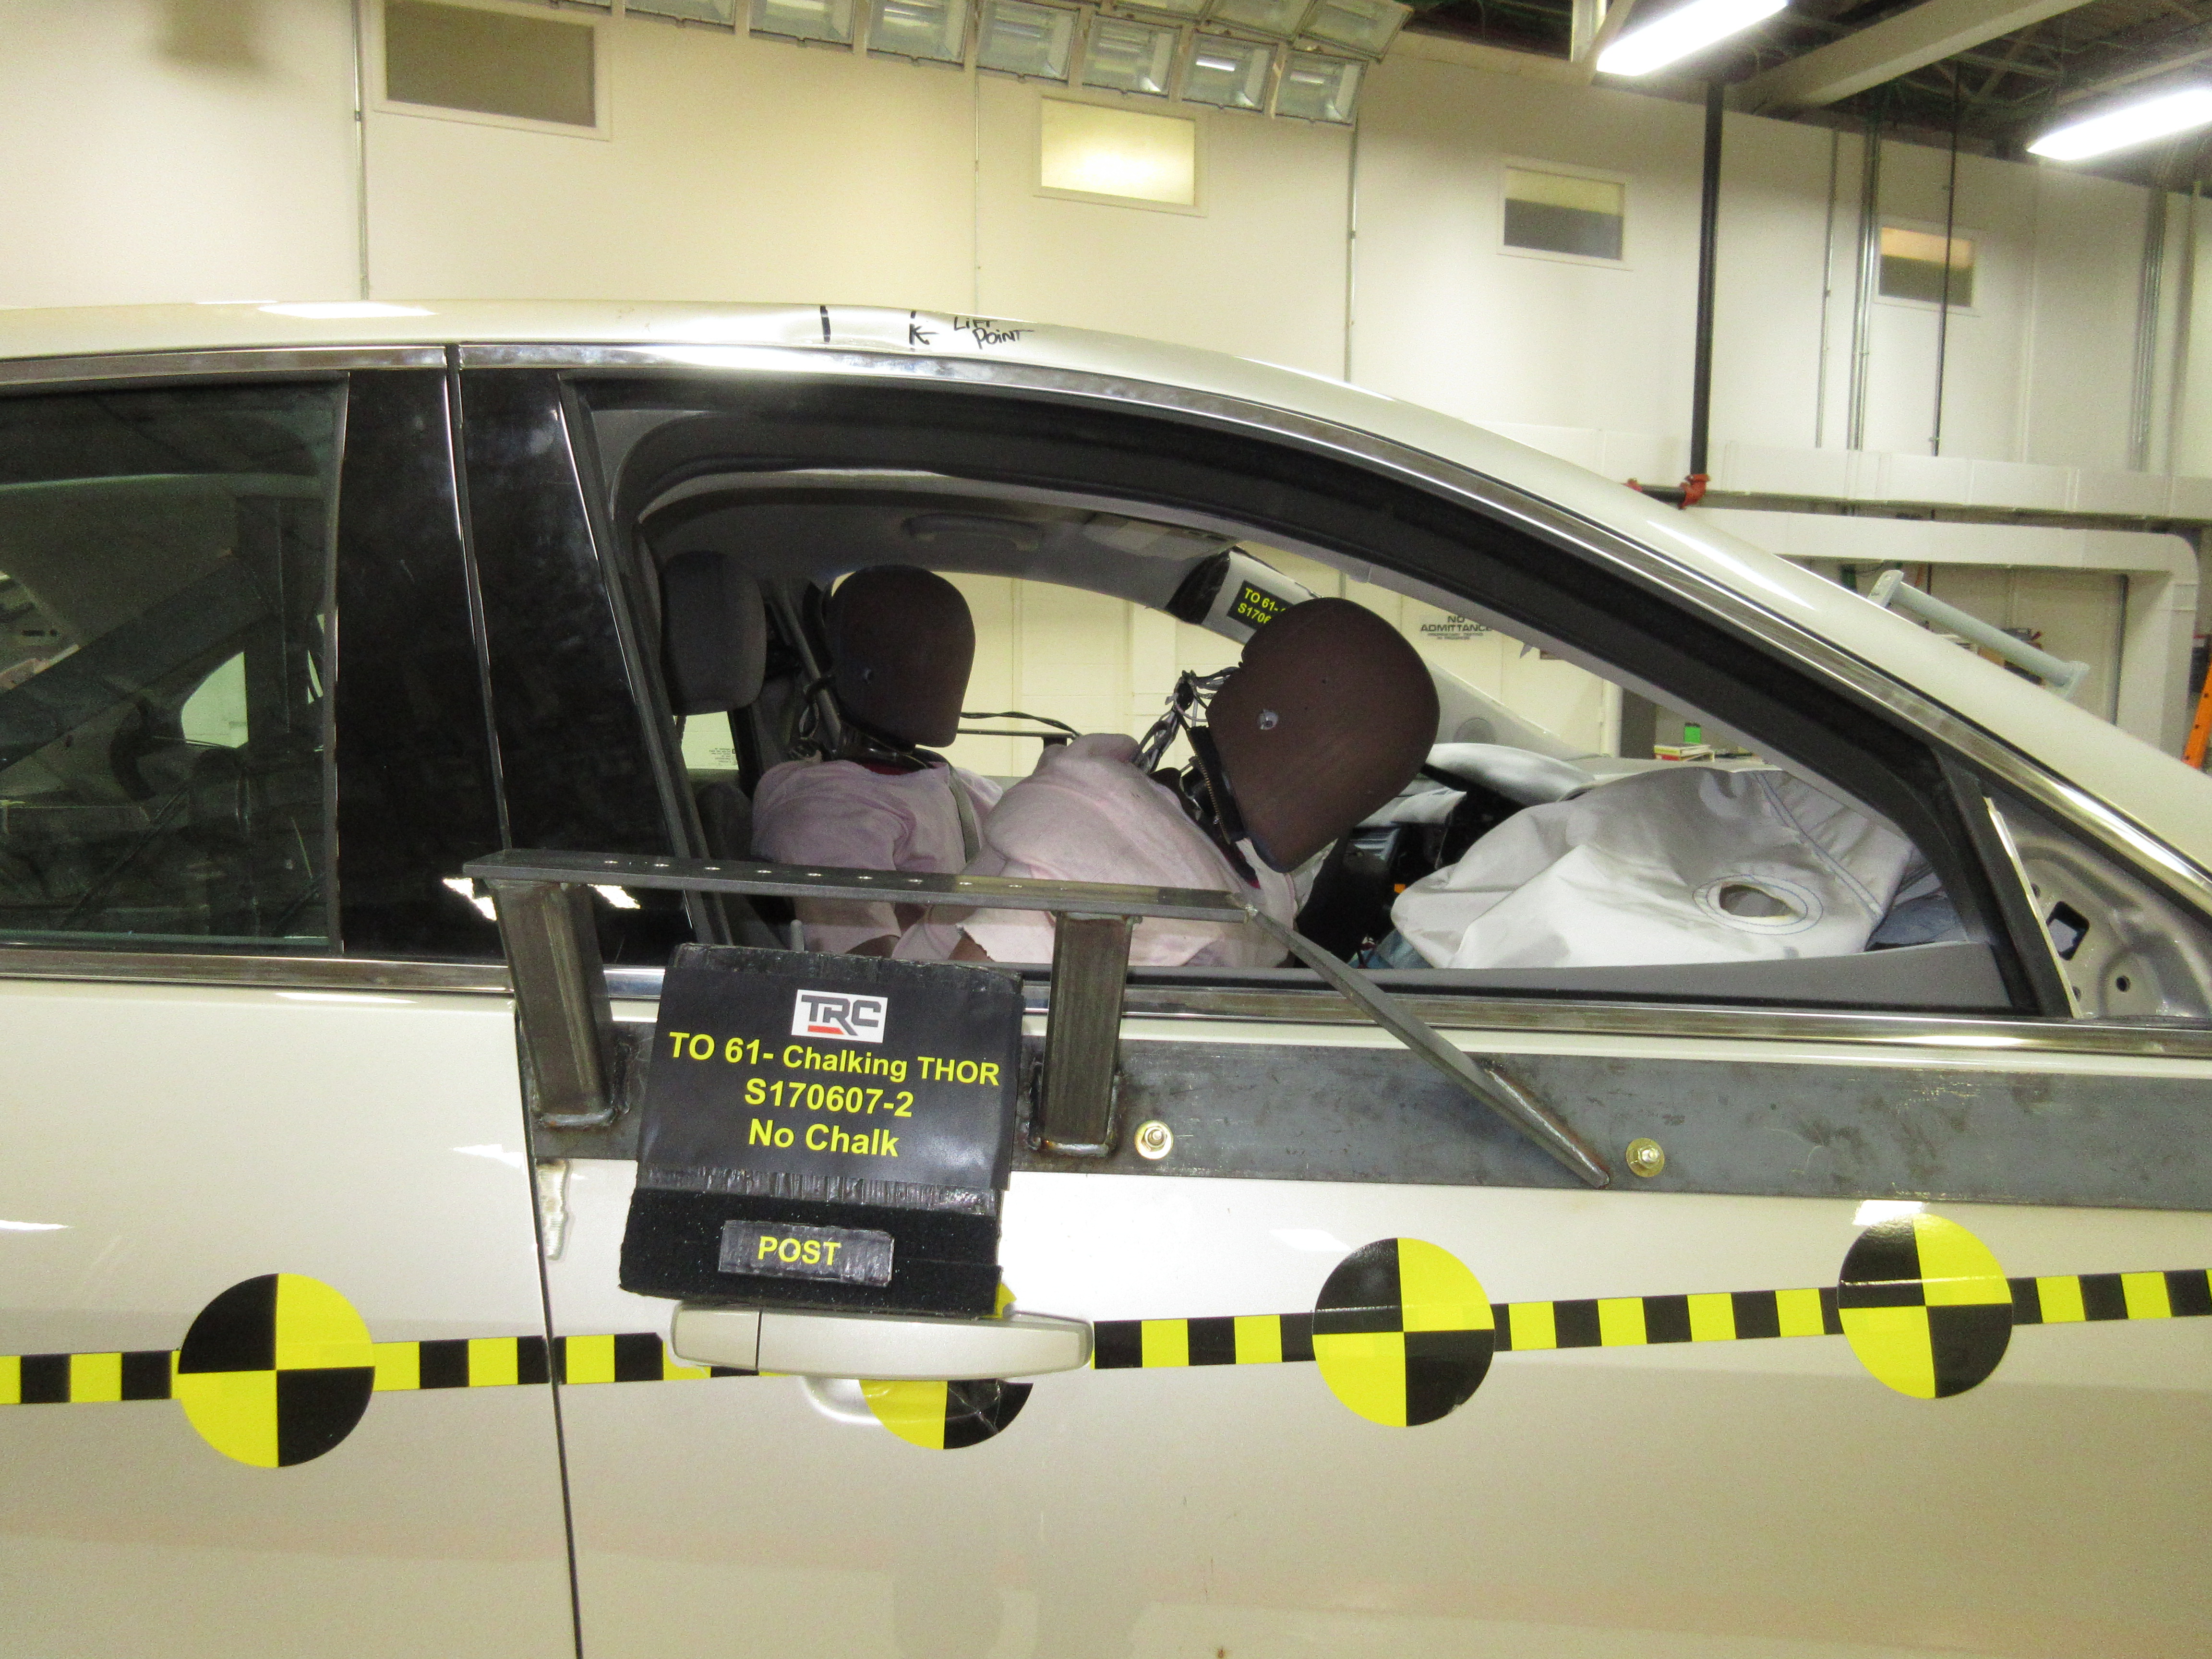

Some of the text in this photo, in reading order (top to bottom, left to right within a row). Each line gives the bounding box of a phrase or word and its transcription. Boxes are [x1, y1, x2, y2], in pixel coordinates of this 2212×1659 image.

[1245, 588, 1278, 611] TO 61-
[801, 994, 881, 1036] TRC
[669, 1031, 1000, 1087] TO 61- Chalking THOR
[744, 1078, 914, 1118] S170607-2
[748, 1118, 899, 1157] No Chalk
[757, 1236, 841, 1266] POST
